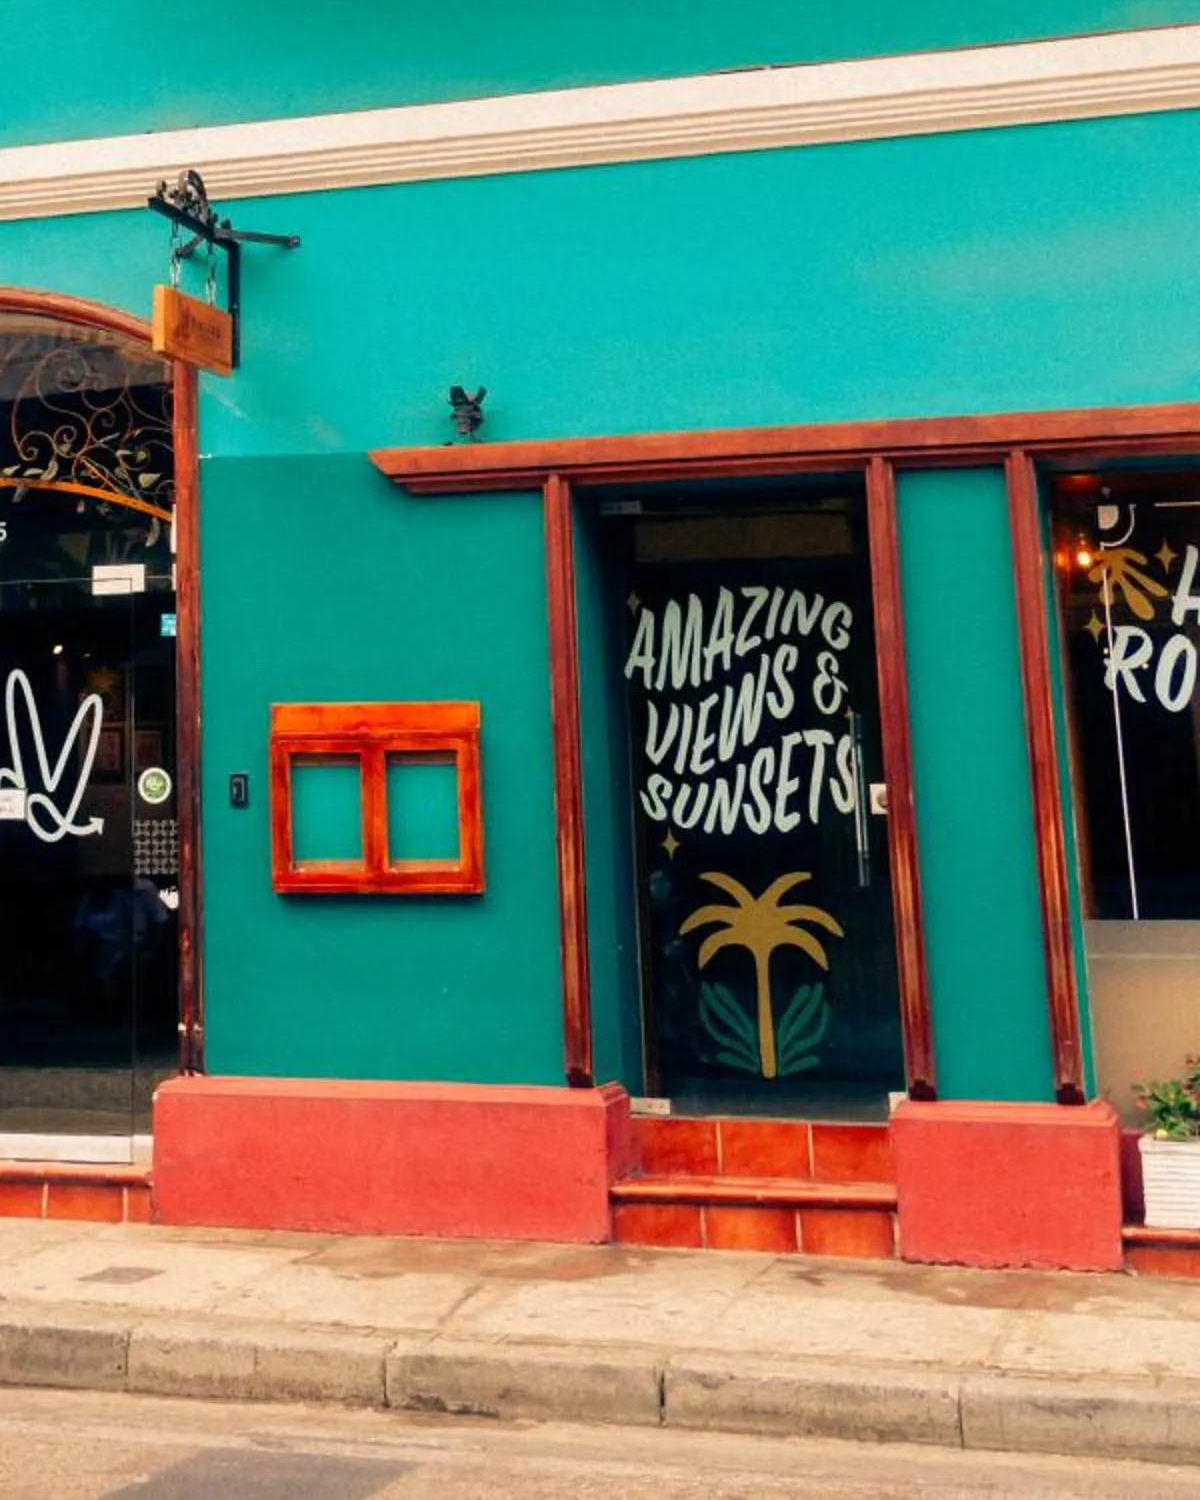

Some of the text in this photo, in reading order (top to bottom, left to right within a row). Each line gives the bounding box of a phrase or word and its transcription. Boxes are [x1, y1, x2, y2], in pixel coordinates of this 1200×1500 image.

[624, 586, 853, 692] AMAZING
[1103, 625, 1198, 712] RO
[645, 644, 849, 775] VIEWS &
[640, 729, 857, 836] SUNSETS
